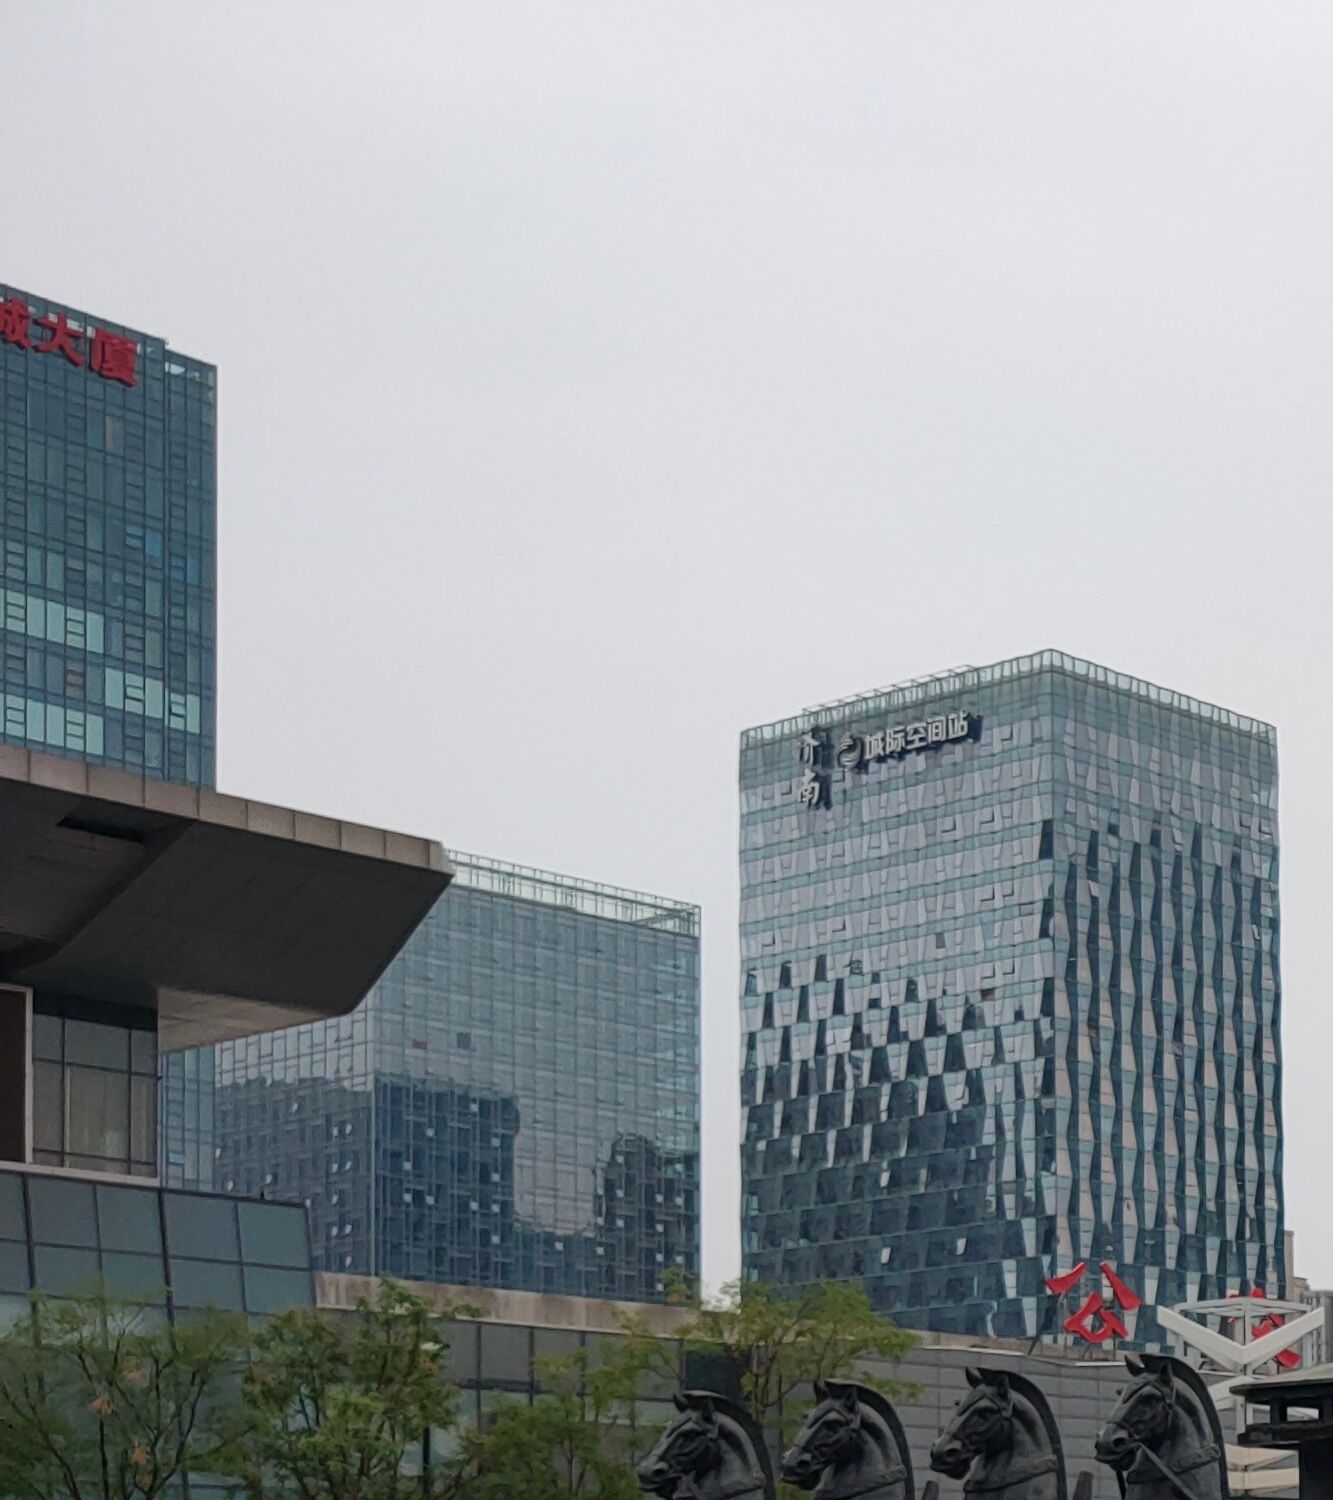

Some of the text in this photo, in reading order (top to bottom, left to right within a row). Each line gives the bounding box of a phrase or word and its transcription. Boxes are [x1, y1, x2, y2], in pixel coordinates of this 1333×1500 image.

[864, 711, 969, 761] 城际空间站
